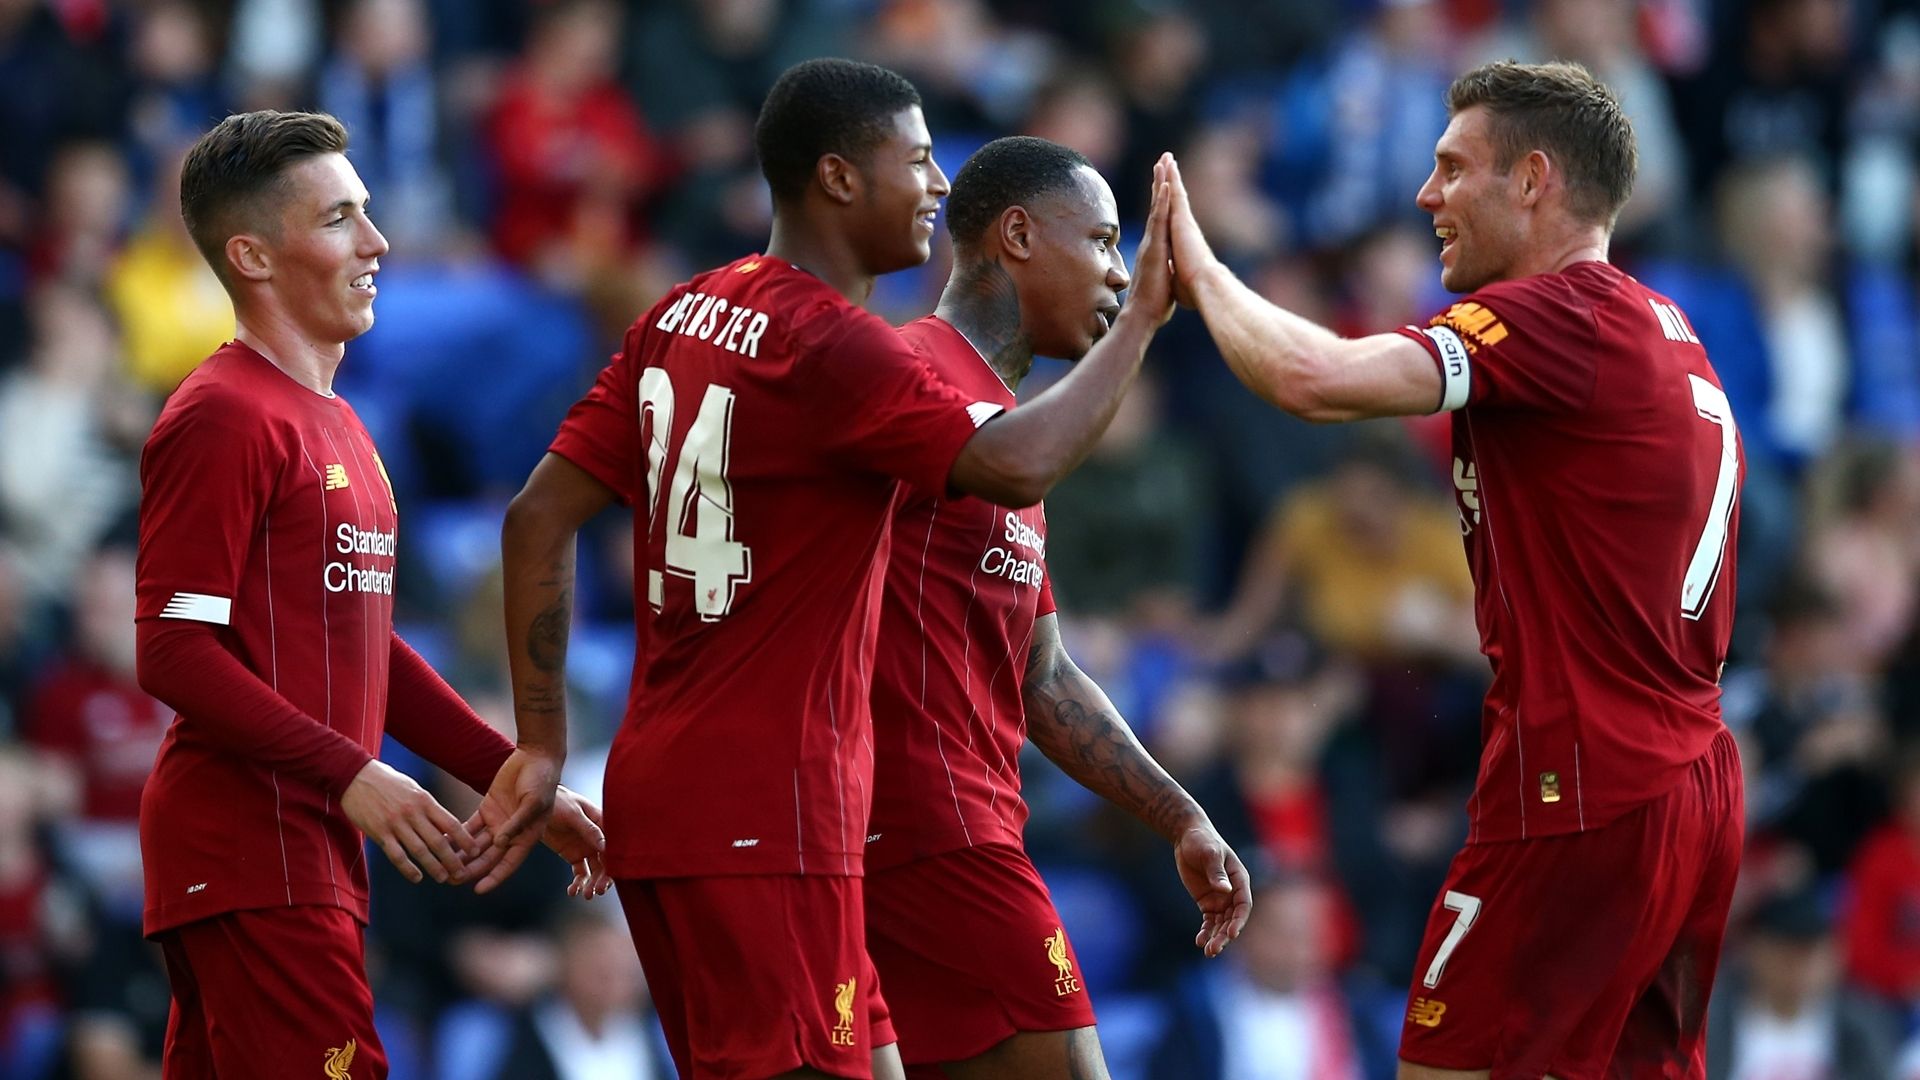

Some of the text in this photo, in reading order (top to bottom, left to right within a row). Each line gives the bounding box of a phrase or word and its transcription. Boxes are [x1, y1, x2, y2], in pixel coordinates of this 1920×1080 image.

[638, 367, 752, 623] 24
[1680, 373, 1739, 622] 7
[336, 522, 395, 557] Standard
[324, 561, 394, 596] Chartered
[1424, 889, 1482, 989] 7
[1055, 977, 1081, 997] LFC
[831, 1030, 855, 1046] LFC
